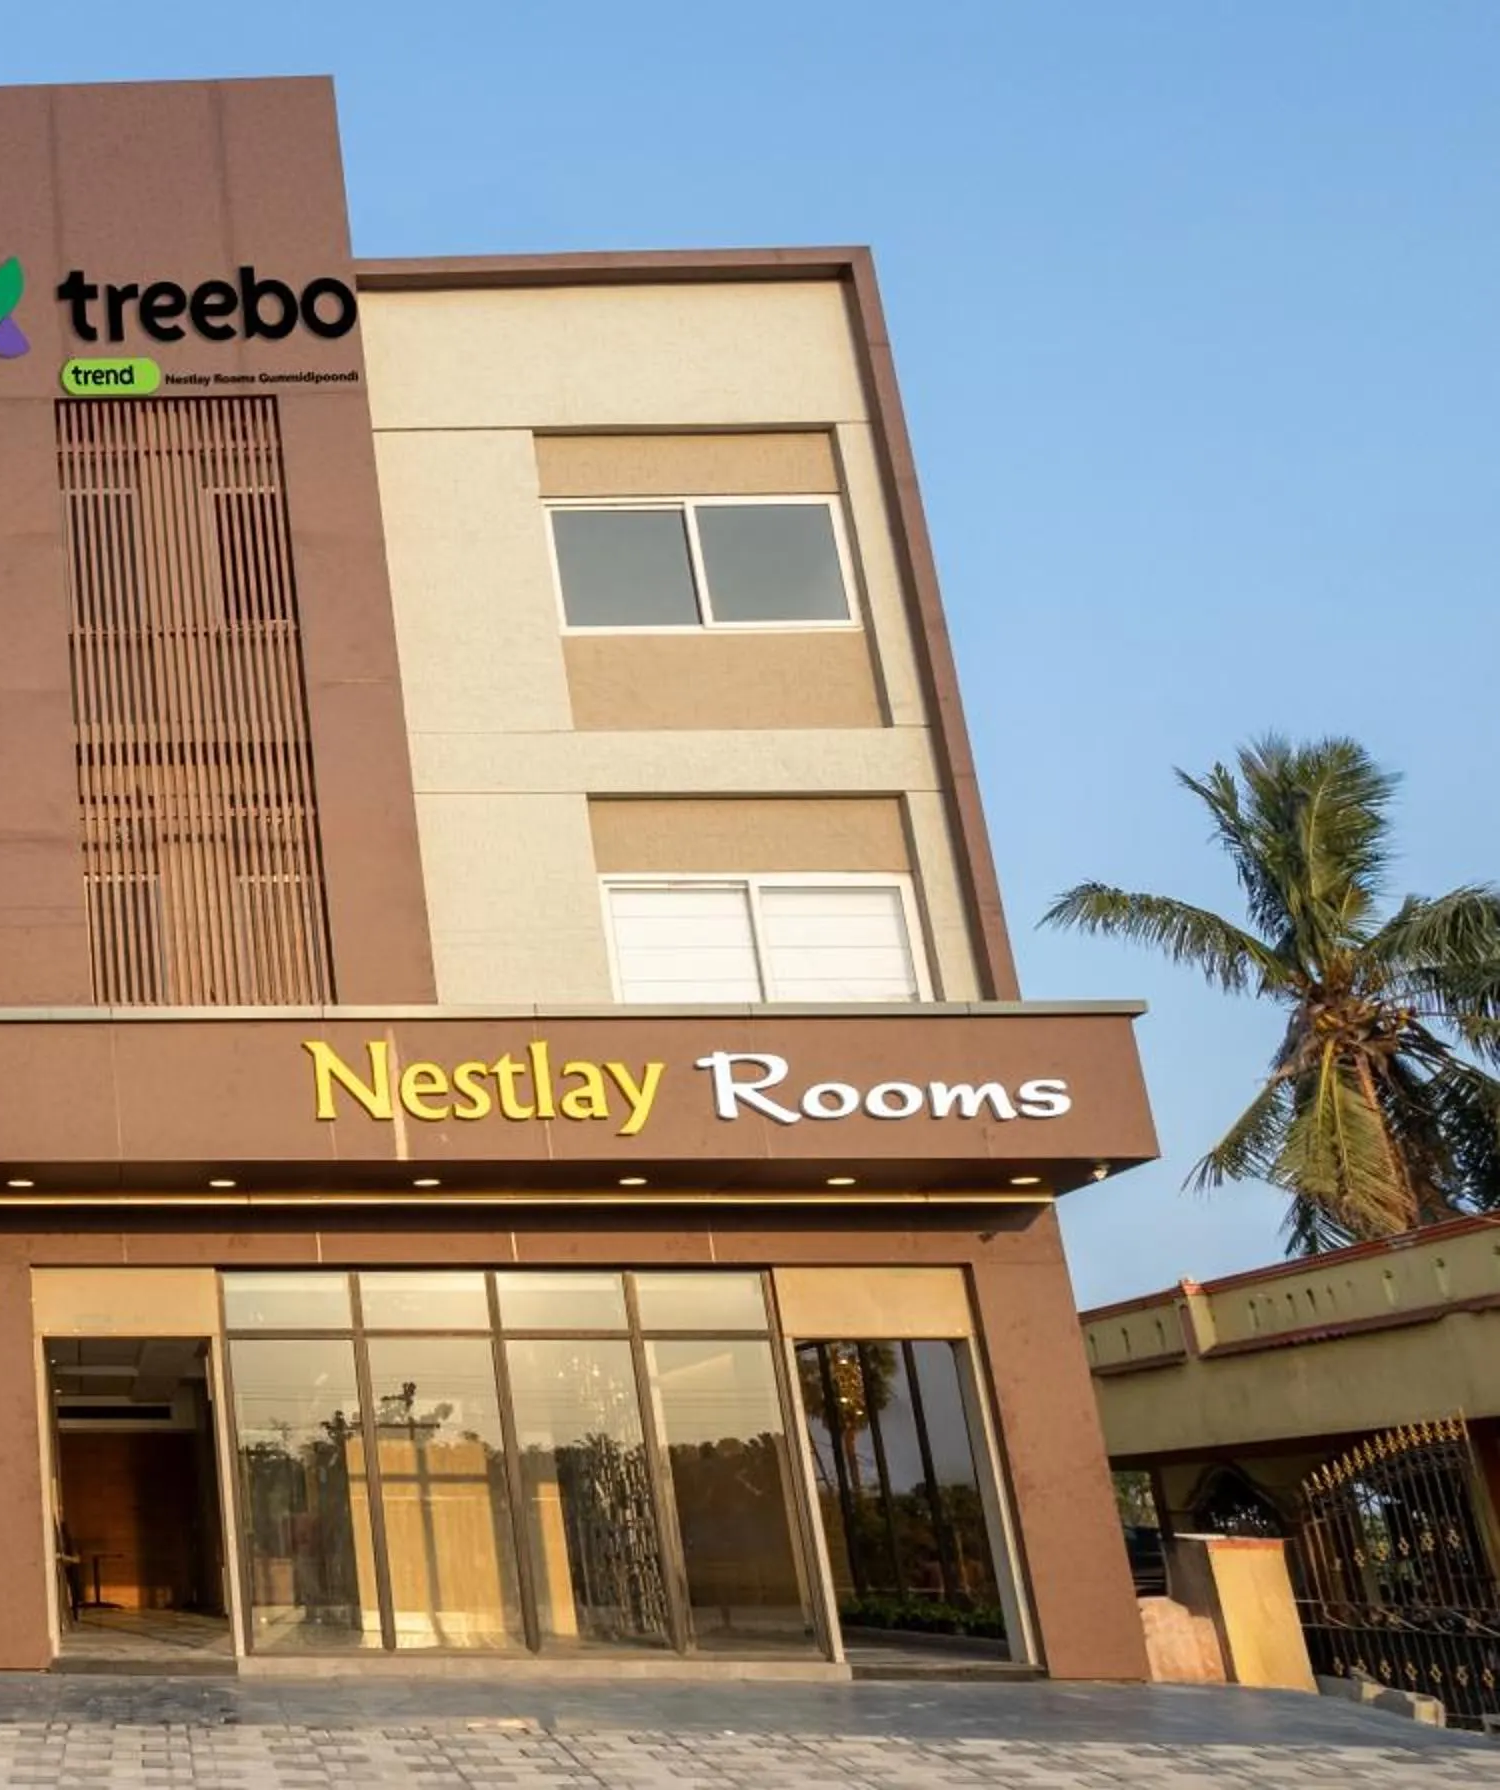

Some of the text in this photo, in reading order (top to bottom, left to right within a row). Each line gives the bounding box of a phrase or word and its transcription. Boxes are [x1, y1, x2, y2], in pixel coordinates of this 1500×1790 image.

[57, 266, 357, 342] treebo
[72, 366, 135, 385] trend
[303, 1040, 1072, 1134] Nestlay Rooms
